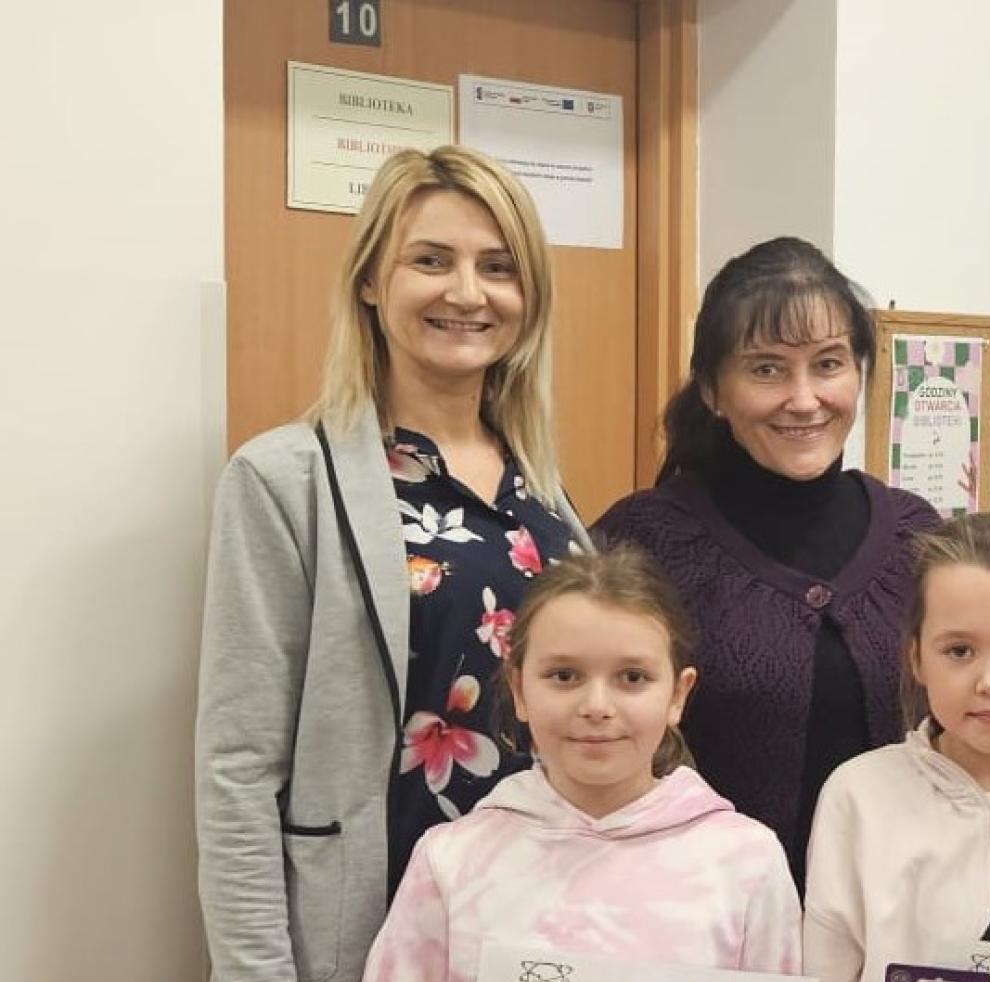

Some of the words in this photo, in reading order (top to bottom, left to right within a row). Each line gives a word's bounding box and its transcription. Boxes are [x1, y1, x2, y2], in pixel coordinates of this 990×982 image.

[336, 1, 377, 37] 10
[339, 92, 413, 117] BIBLIOTEKA
[920, 386, 957, 398] GODZINY
[914, 400, 961, 411] OTWARCIA
